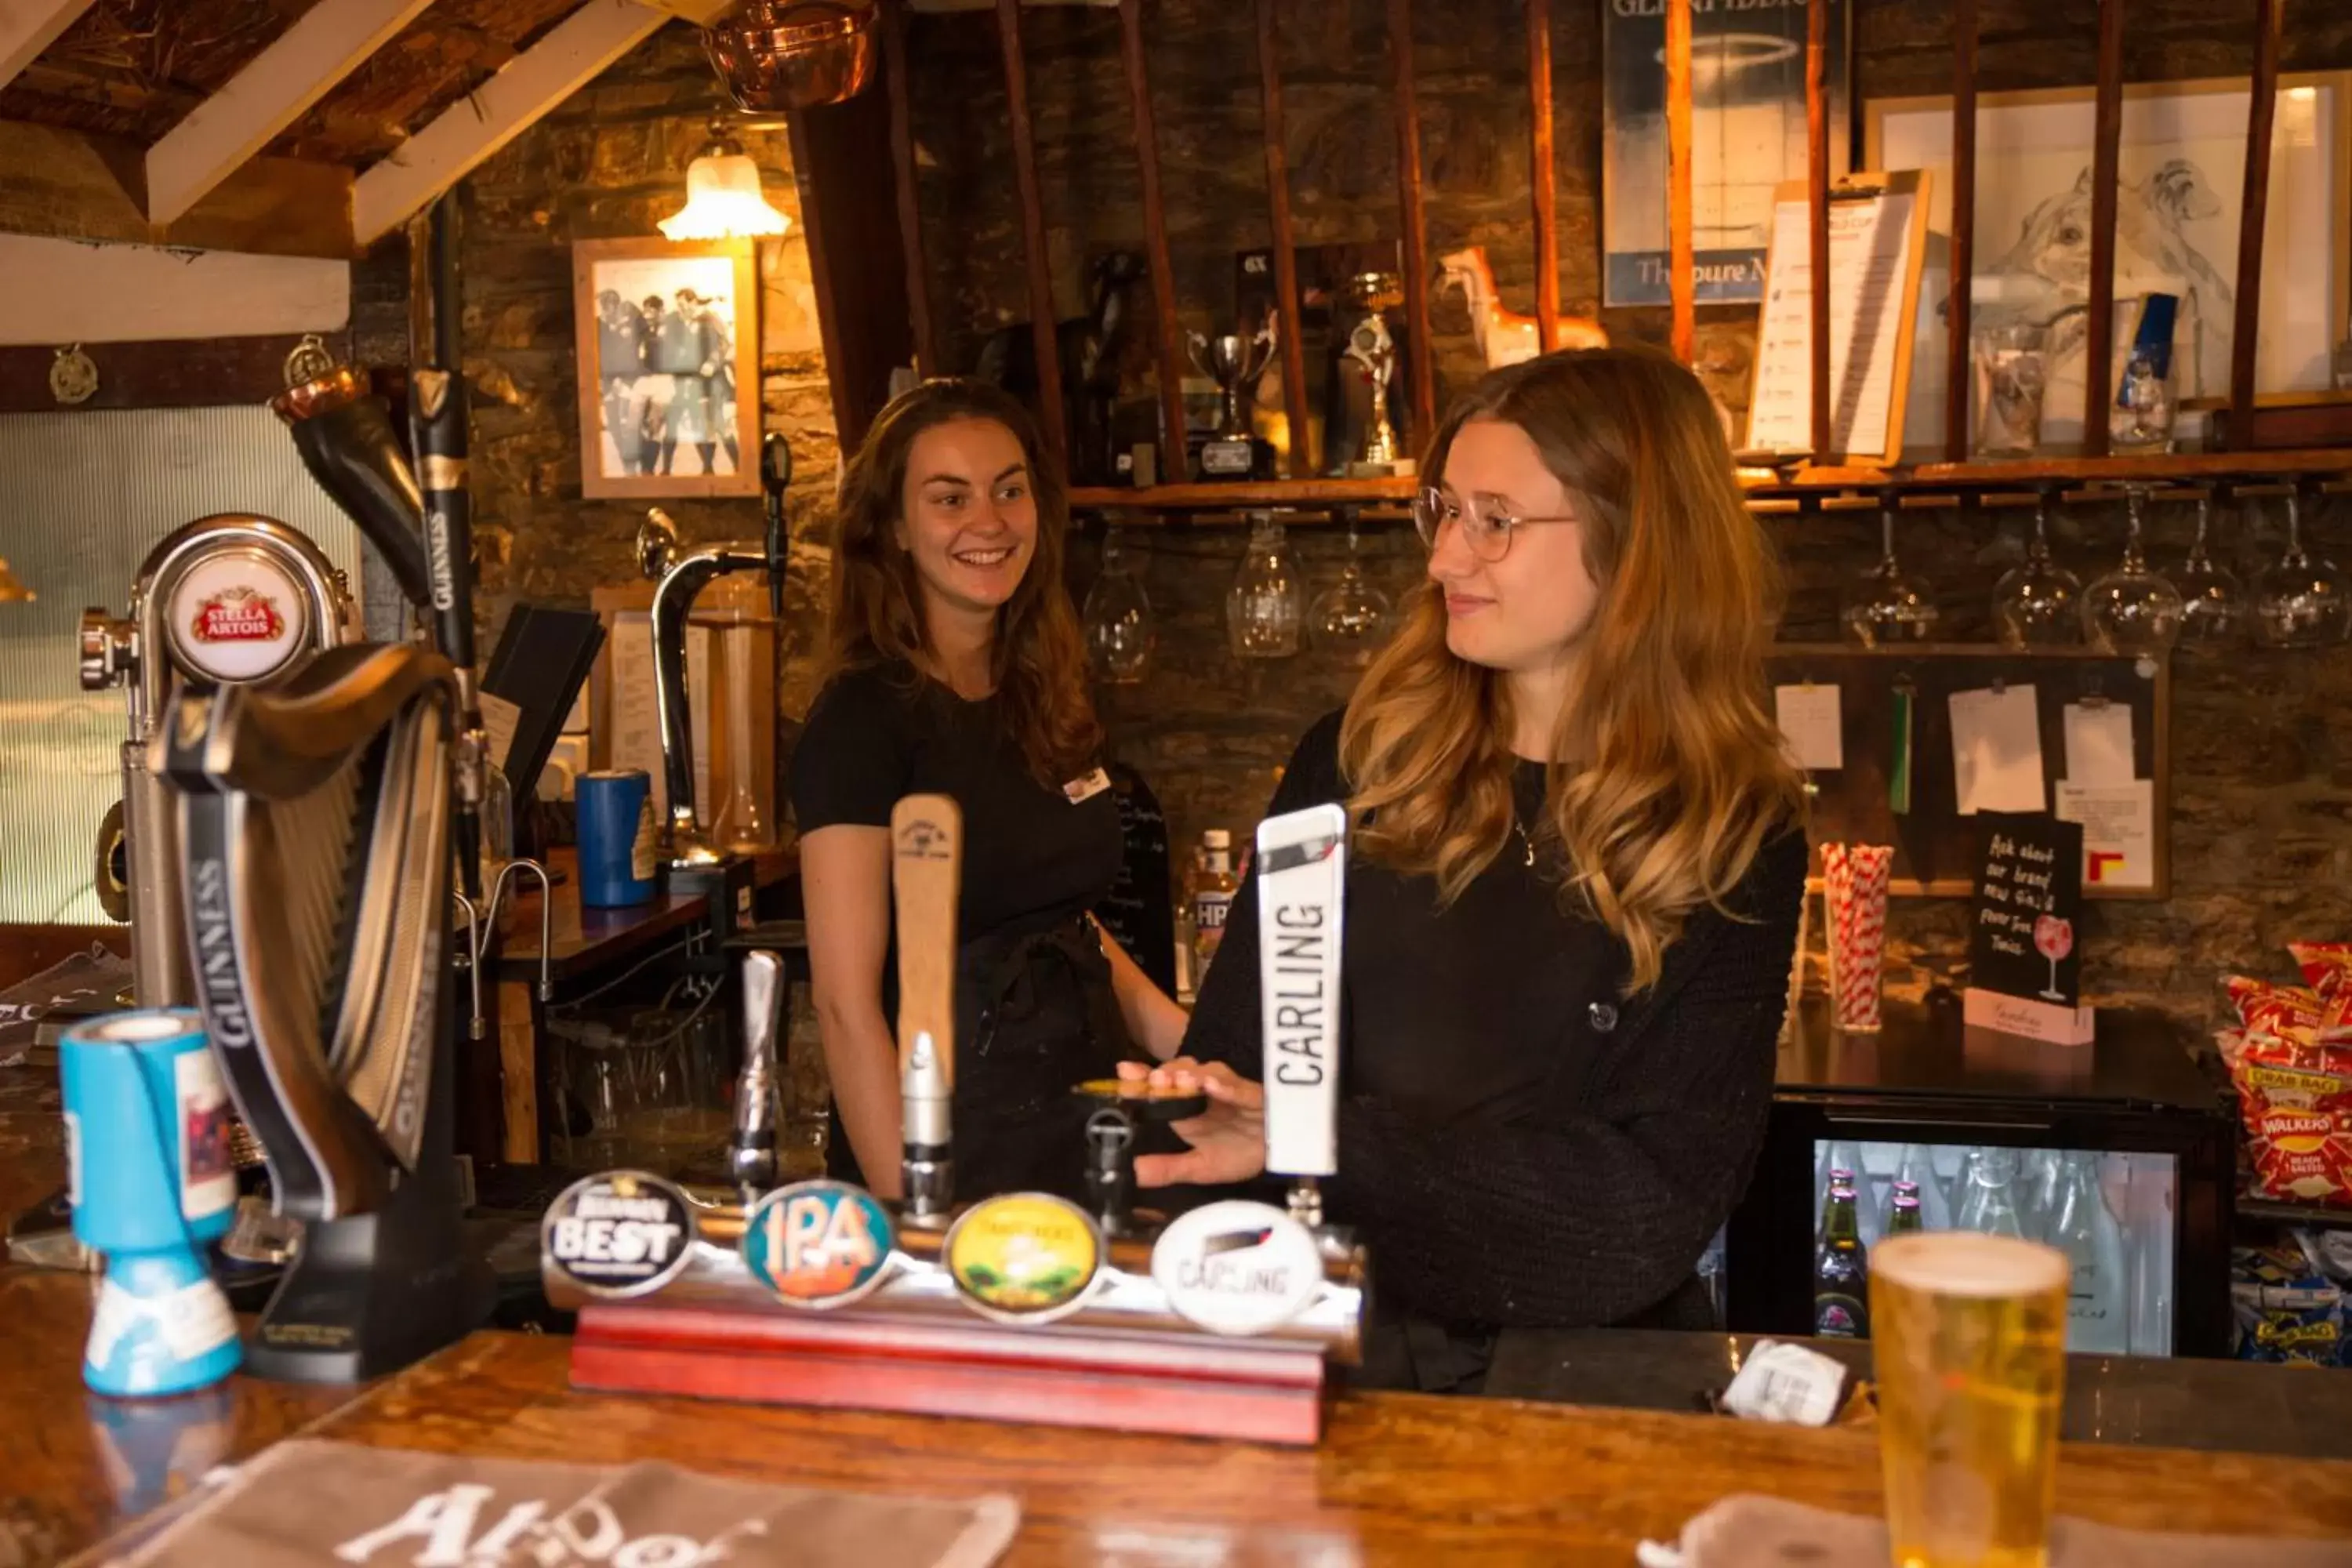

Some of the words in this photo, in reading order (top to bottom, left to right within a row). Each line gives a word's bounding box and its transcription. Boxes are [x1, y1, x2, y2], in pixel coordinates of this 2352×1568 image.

[1636, 257, 1672, 285] Th
[430, 512, 455, 611] GUINNESS
[207, 606, 267, 623] STELLA
[207, 622, 268, 637] ARTOIS
[1198, 906, 1228, 926] HP
[1276, 905, 1323, 1087] CARLING
[2252, 1068, 2296, 1085] GRAB
[2300, 1077, 2338, 1091] BAG
[2263, 1118, 2330, 1134] WALKERS
[554, 1218, 681, 1264] BEST
[762, 1196, 877, 1275] IPA
[1178, 1258, 1290, 1296] CAING
